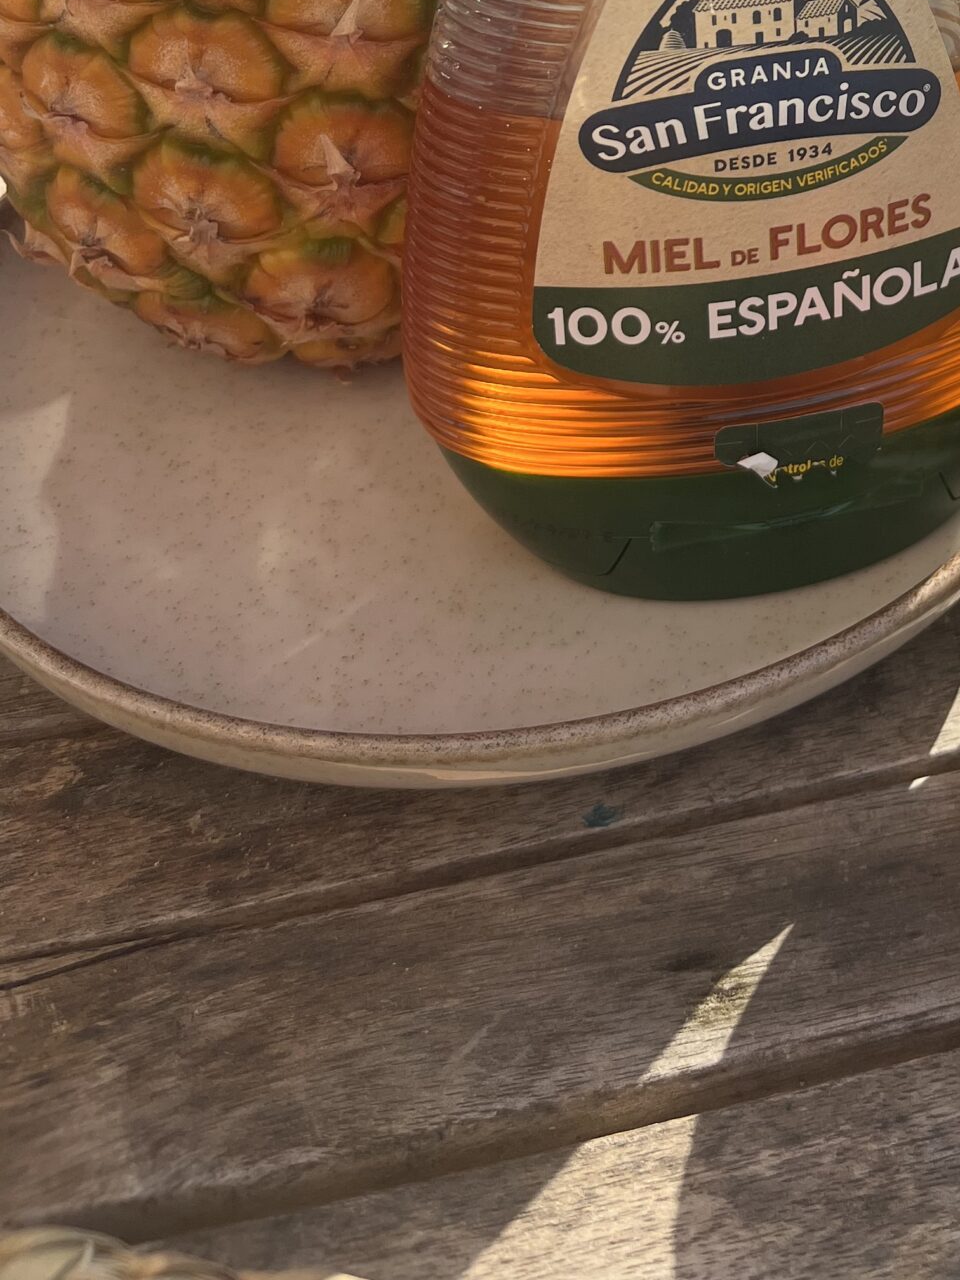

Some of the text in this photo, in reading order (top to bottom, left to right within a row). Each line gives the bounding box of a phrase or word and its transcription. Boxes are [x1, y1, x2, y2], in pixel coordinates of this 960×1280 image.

[706, 57, 830, 91] GRANJA
[591, 82, 927, 161] San Francisco
[714, 142, 833, 173] DESDE 1934
[651, 171, 719, 196] CALIDAD
[723, 183, 732, 196] Y
[734, 177, 793, 196] ORIGEN
[602, 193, 932, 276] MIEL DE FLORES
[547, 306, 686, 346] 100%
[829, 454, 844, 469] de
